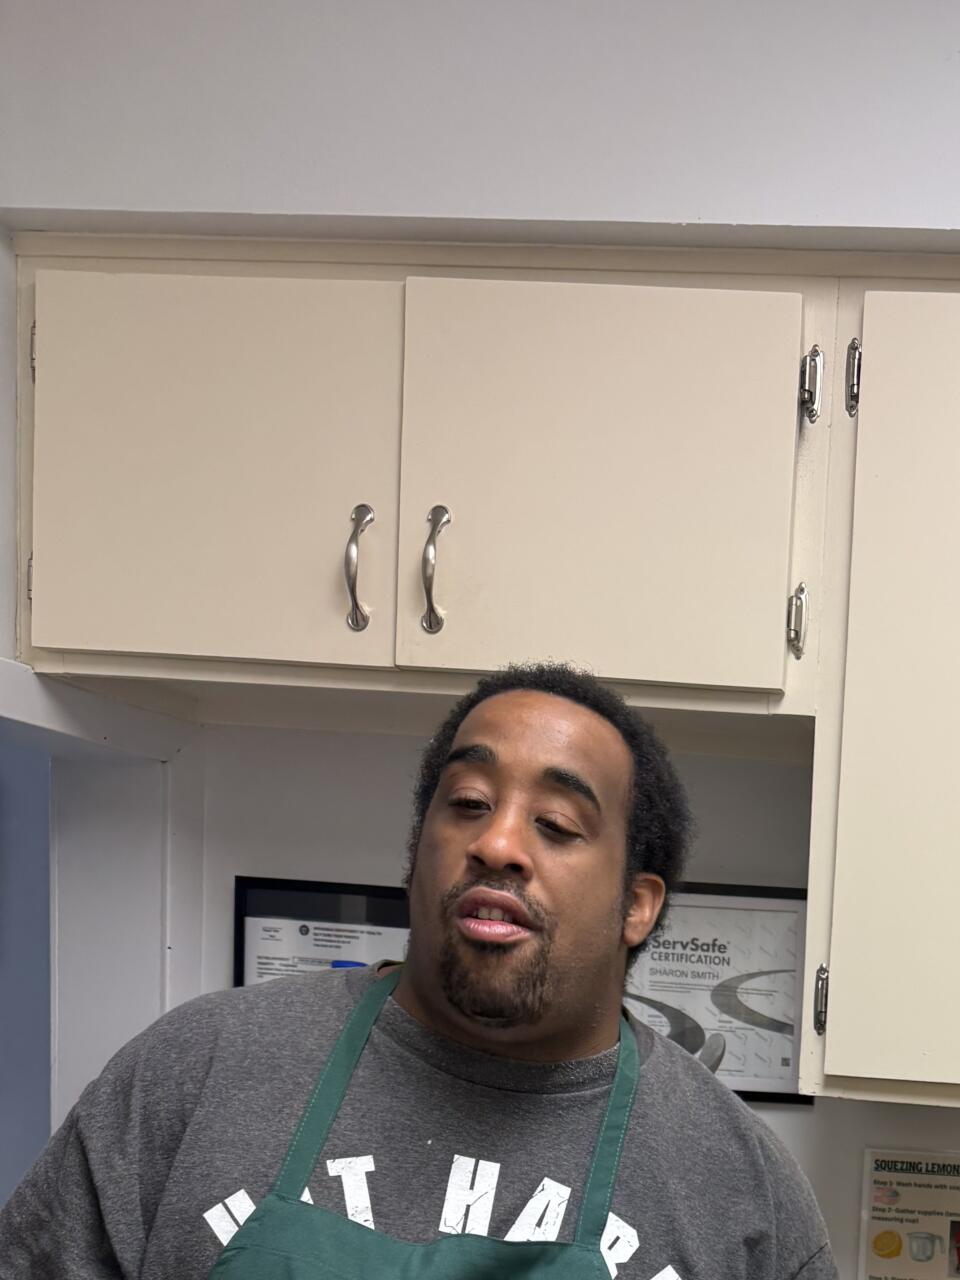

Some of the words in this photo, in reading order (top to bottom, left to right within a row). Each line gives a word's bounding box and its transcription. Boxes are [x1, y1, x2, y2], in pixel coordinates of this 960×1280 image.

[652, 935, 728, 954] ServSafe
[651, 951, 730, 966] CERTIFICATION
[649, 967, 688, 979] SHARON
[690, 970, 719, 981] SMITH
